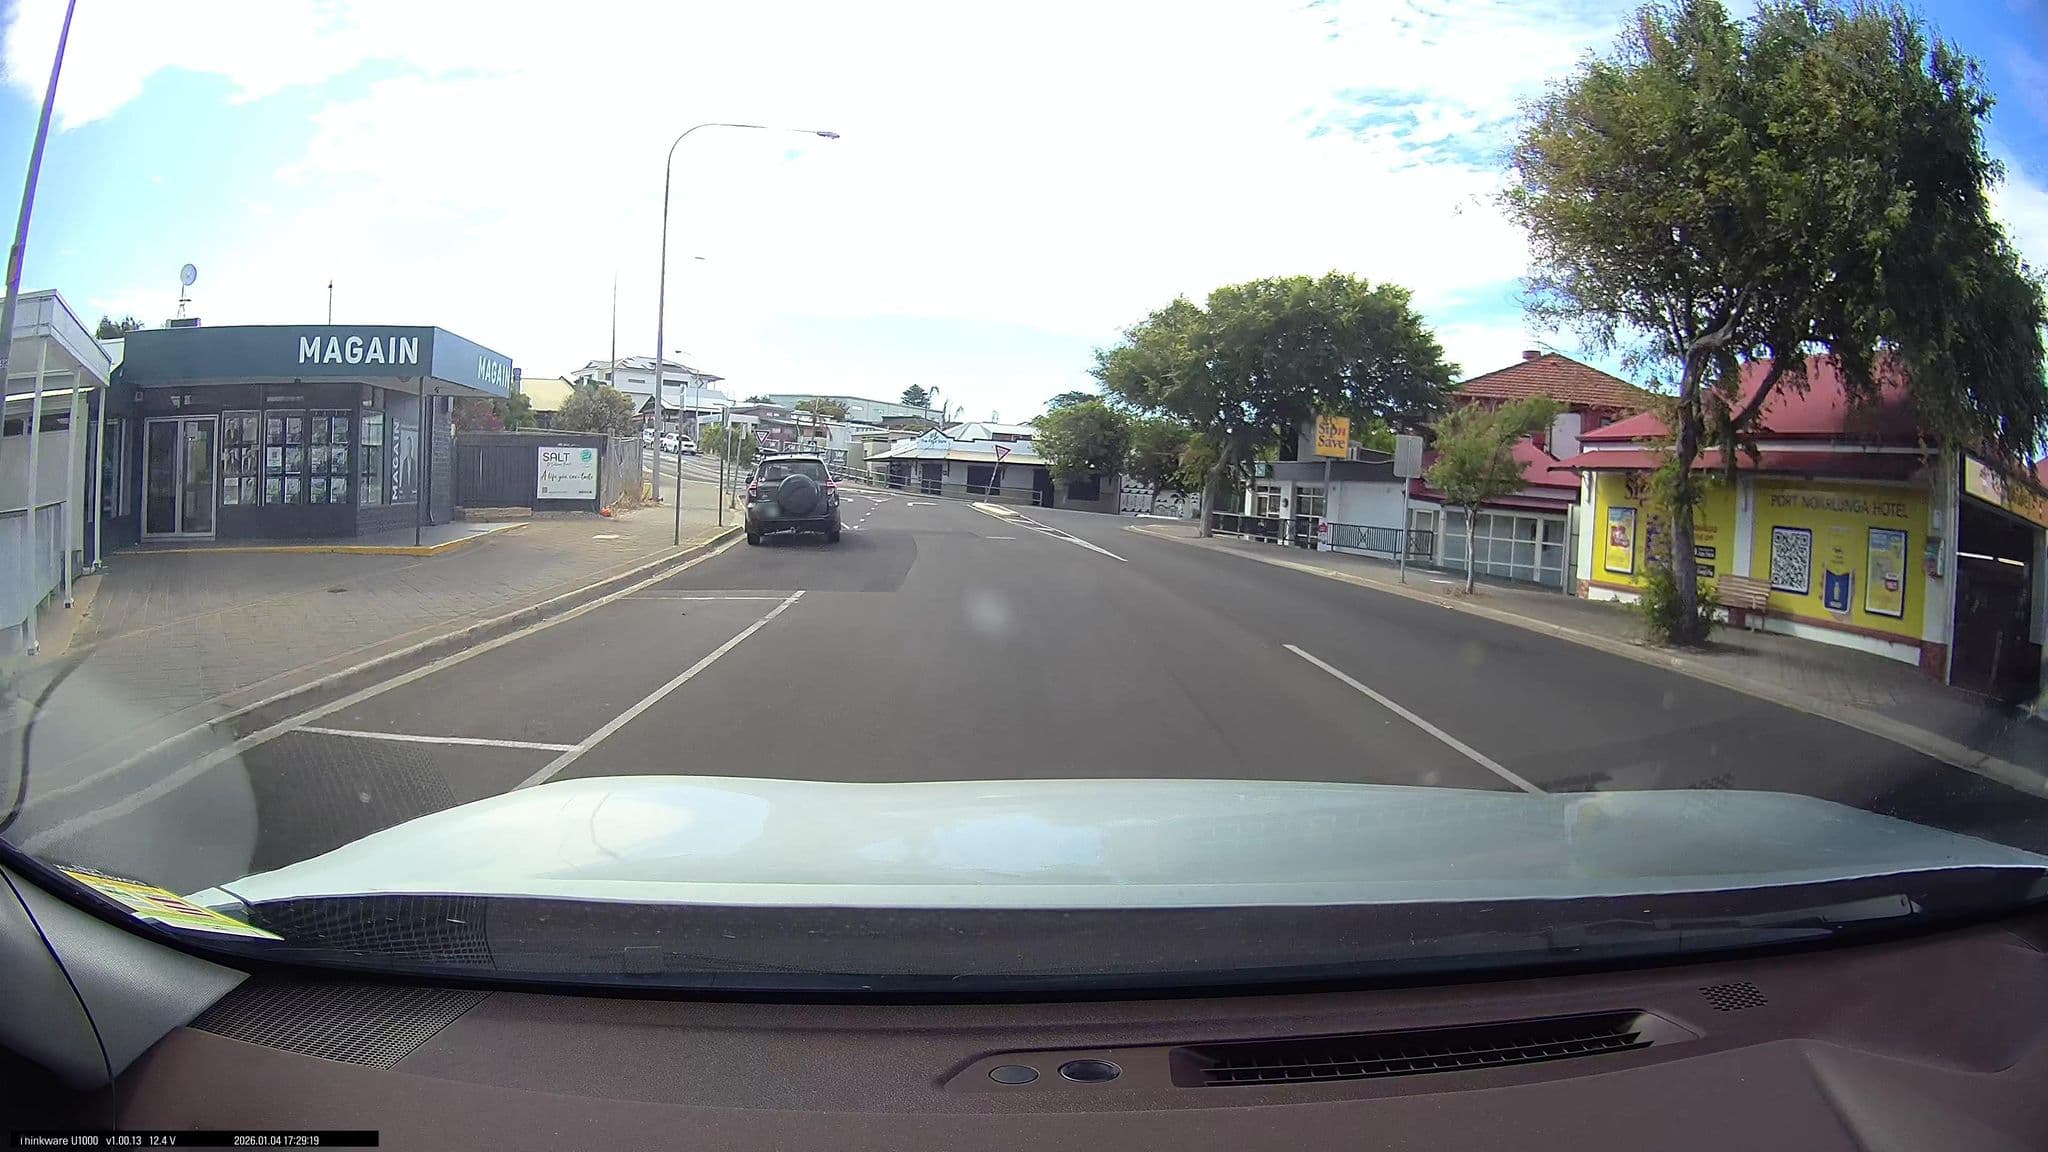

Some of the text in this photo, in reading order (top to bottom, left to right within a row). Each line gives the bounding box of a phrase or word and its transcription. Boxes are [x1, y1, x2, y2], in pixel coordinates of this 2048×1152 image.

[298, 335, 419, 365] MAGAIN
[477, 355, 511, 388] MAGAIN
[1317, 435, 1345, 449] Save
[392, 421, 400, 500] MAGAIN
[542, 452, 571, 462] SALT
[1770, 494, 1798, 508] PORT
[1873, 501, 1909, 519] HOTEL
